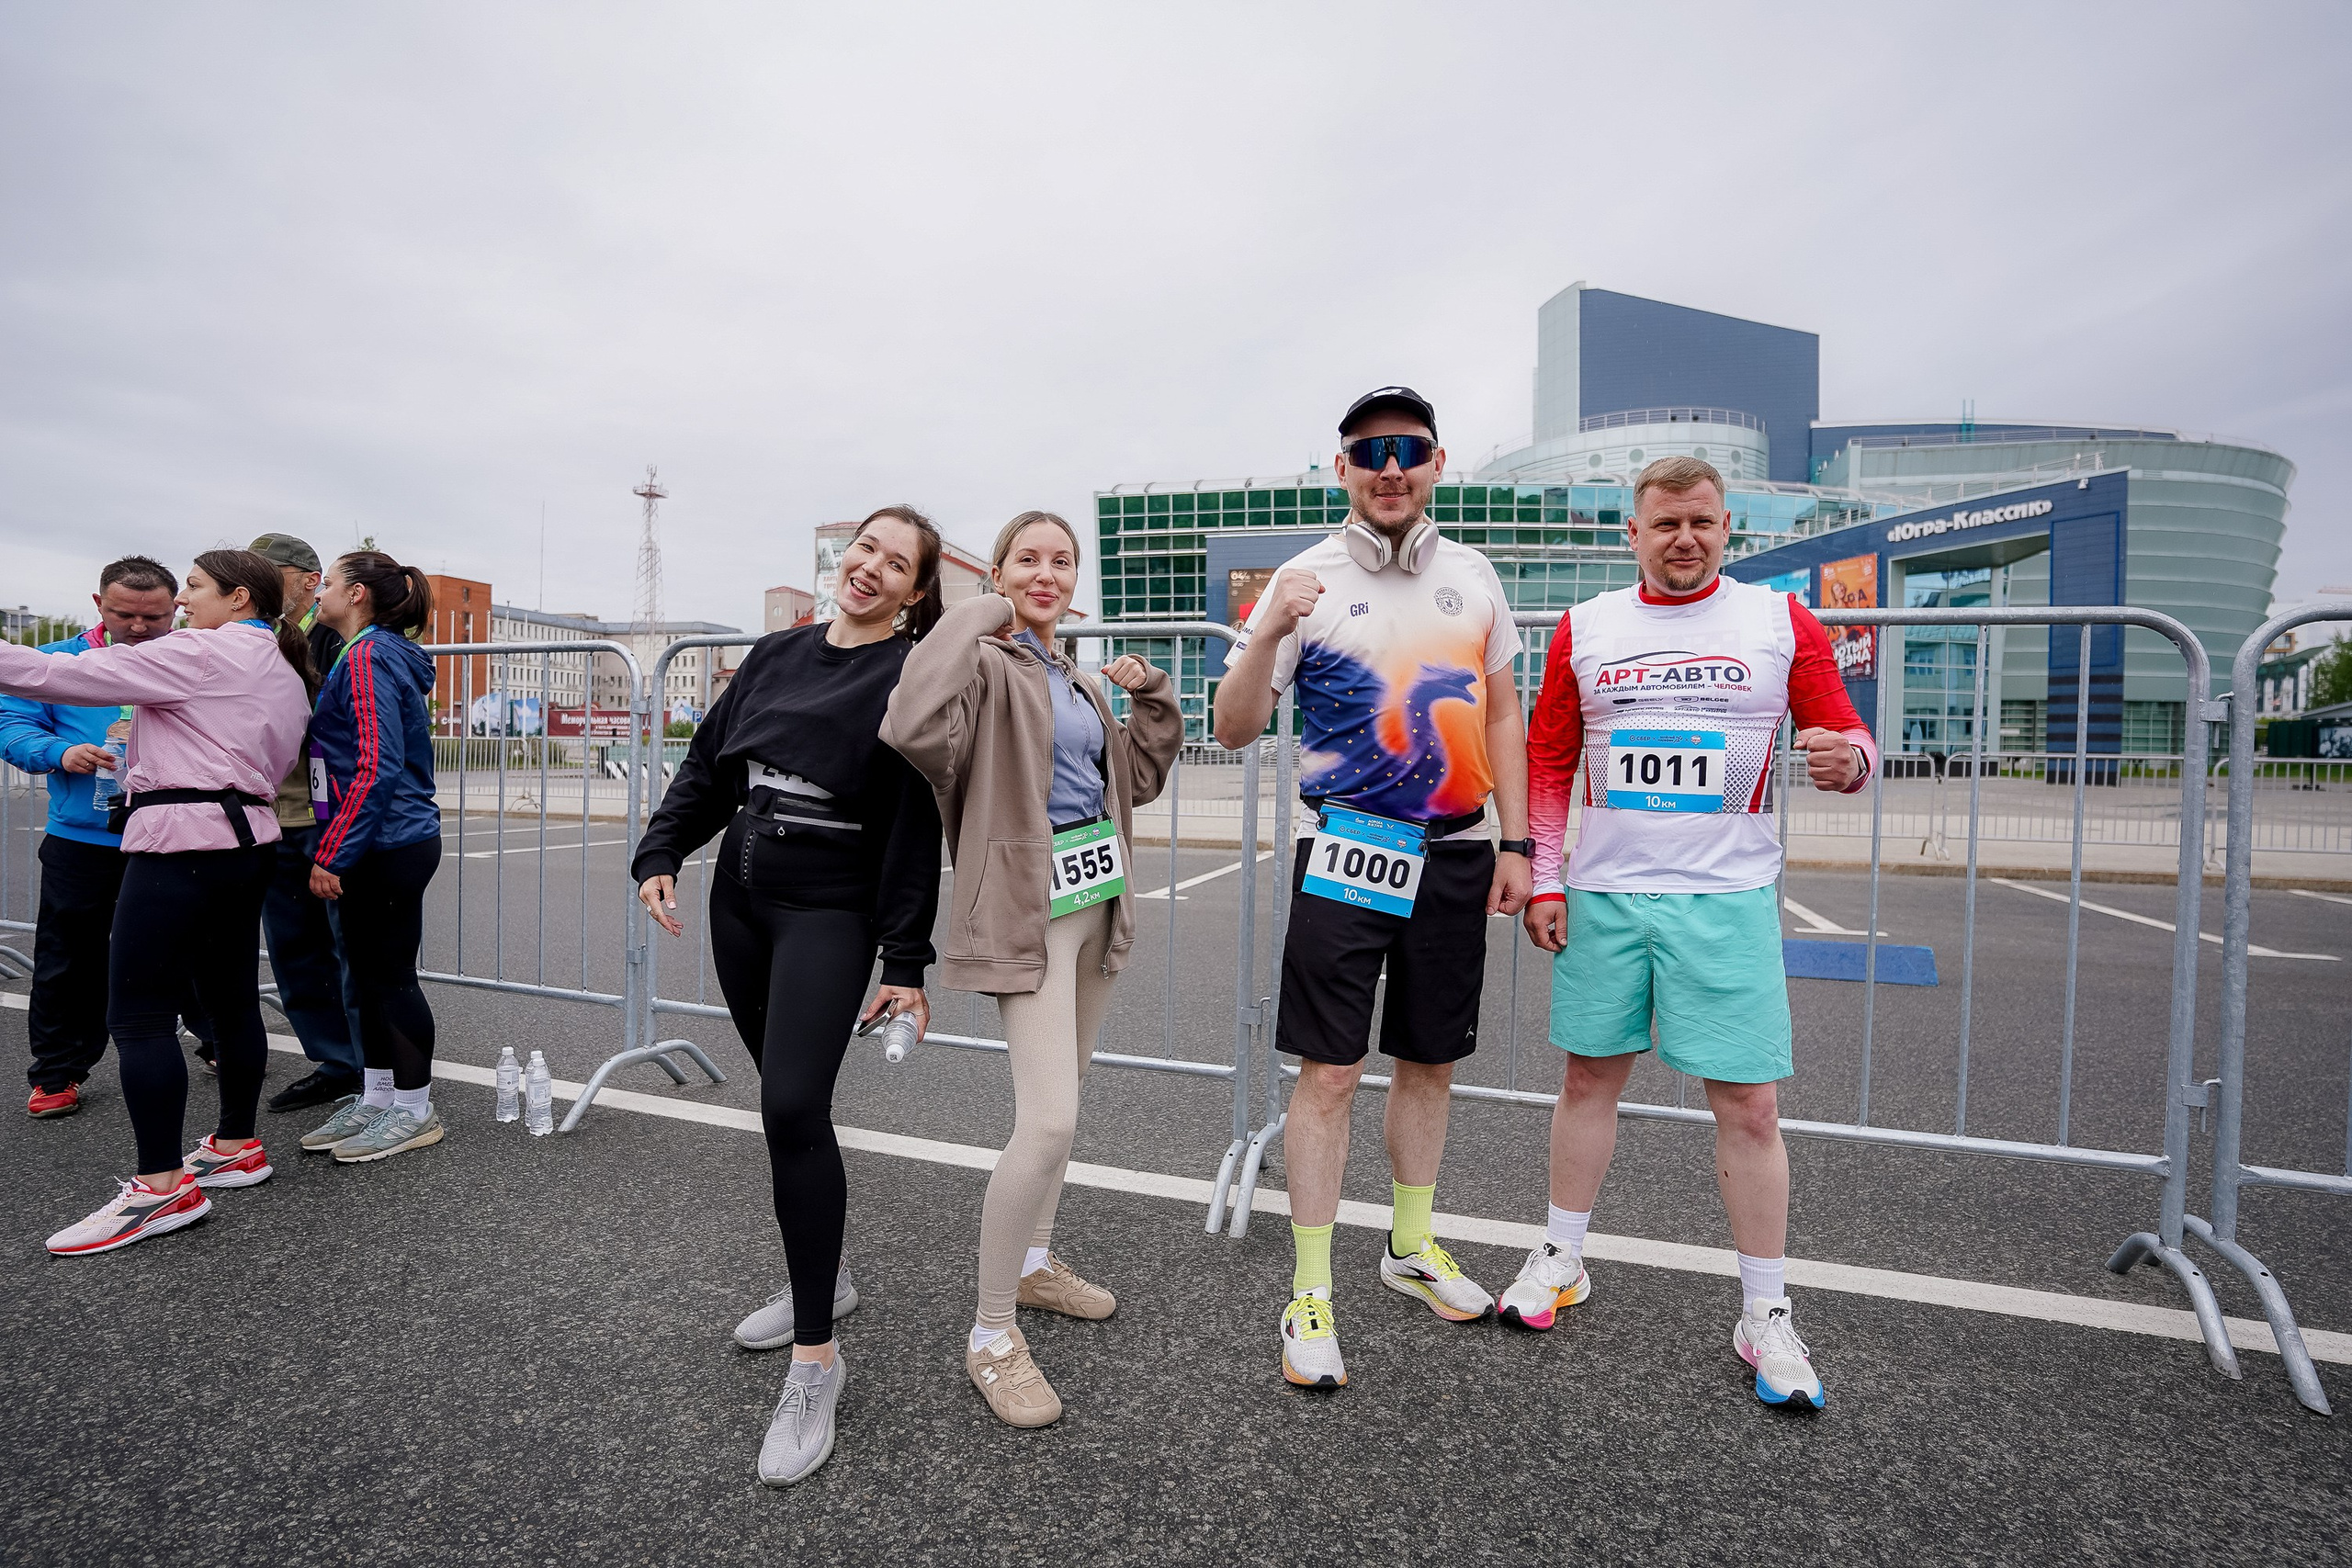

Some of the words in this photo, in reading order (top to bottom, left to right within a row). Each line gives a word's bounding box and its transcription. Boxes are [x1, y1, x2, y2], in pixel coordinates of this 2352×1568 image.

[1887, 500, 2053, 542] «Югра-Классик»
[1834, 633, 1871, 660] ЮТЫЙ
[1595, 666, 1745, 687] АРТ-АВТО
[1601, 685, 1639, 694] КАЖДЫМ
[1640, 682, 1705, 691] АВТОМОБИЛЕМ
[1713, 682, 1752, 693] ЧЕЛОВЕК
[1620, 753, 1708, 787] 1011
[1324, 841, 1411, 889] 1000
